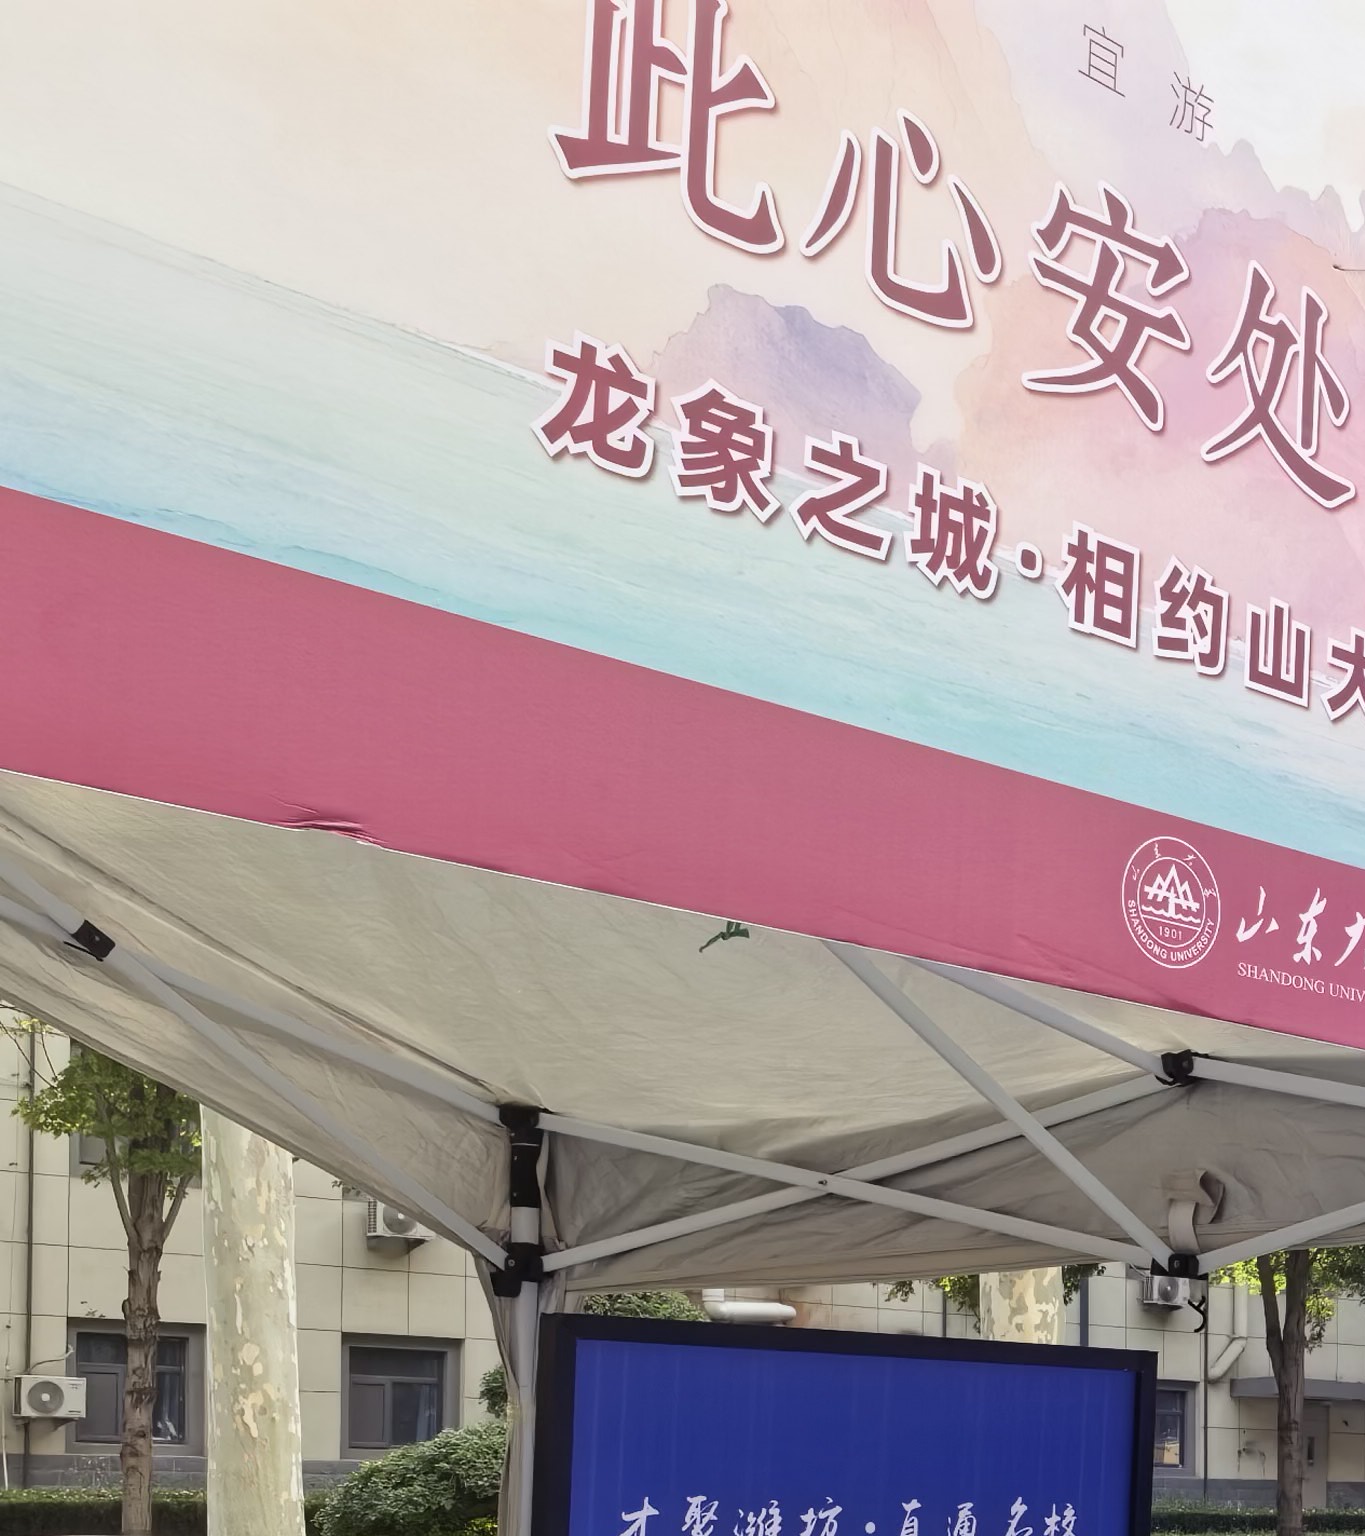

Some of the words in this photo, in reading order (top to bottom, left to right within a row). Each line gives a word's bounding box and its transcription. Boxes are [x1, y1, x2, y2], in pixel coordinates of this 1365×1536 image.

[1077, 24, 1216, 144] 宜游
[1126, 898, 1168, 960] SHANDONG
[1170, 917, 1216, 963] UNIVERSITY
[1158, 924, 1184, 942] 1901
[1237, 961, 1326, 995] SHANDONG
